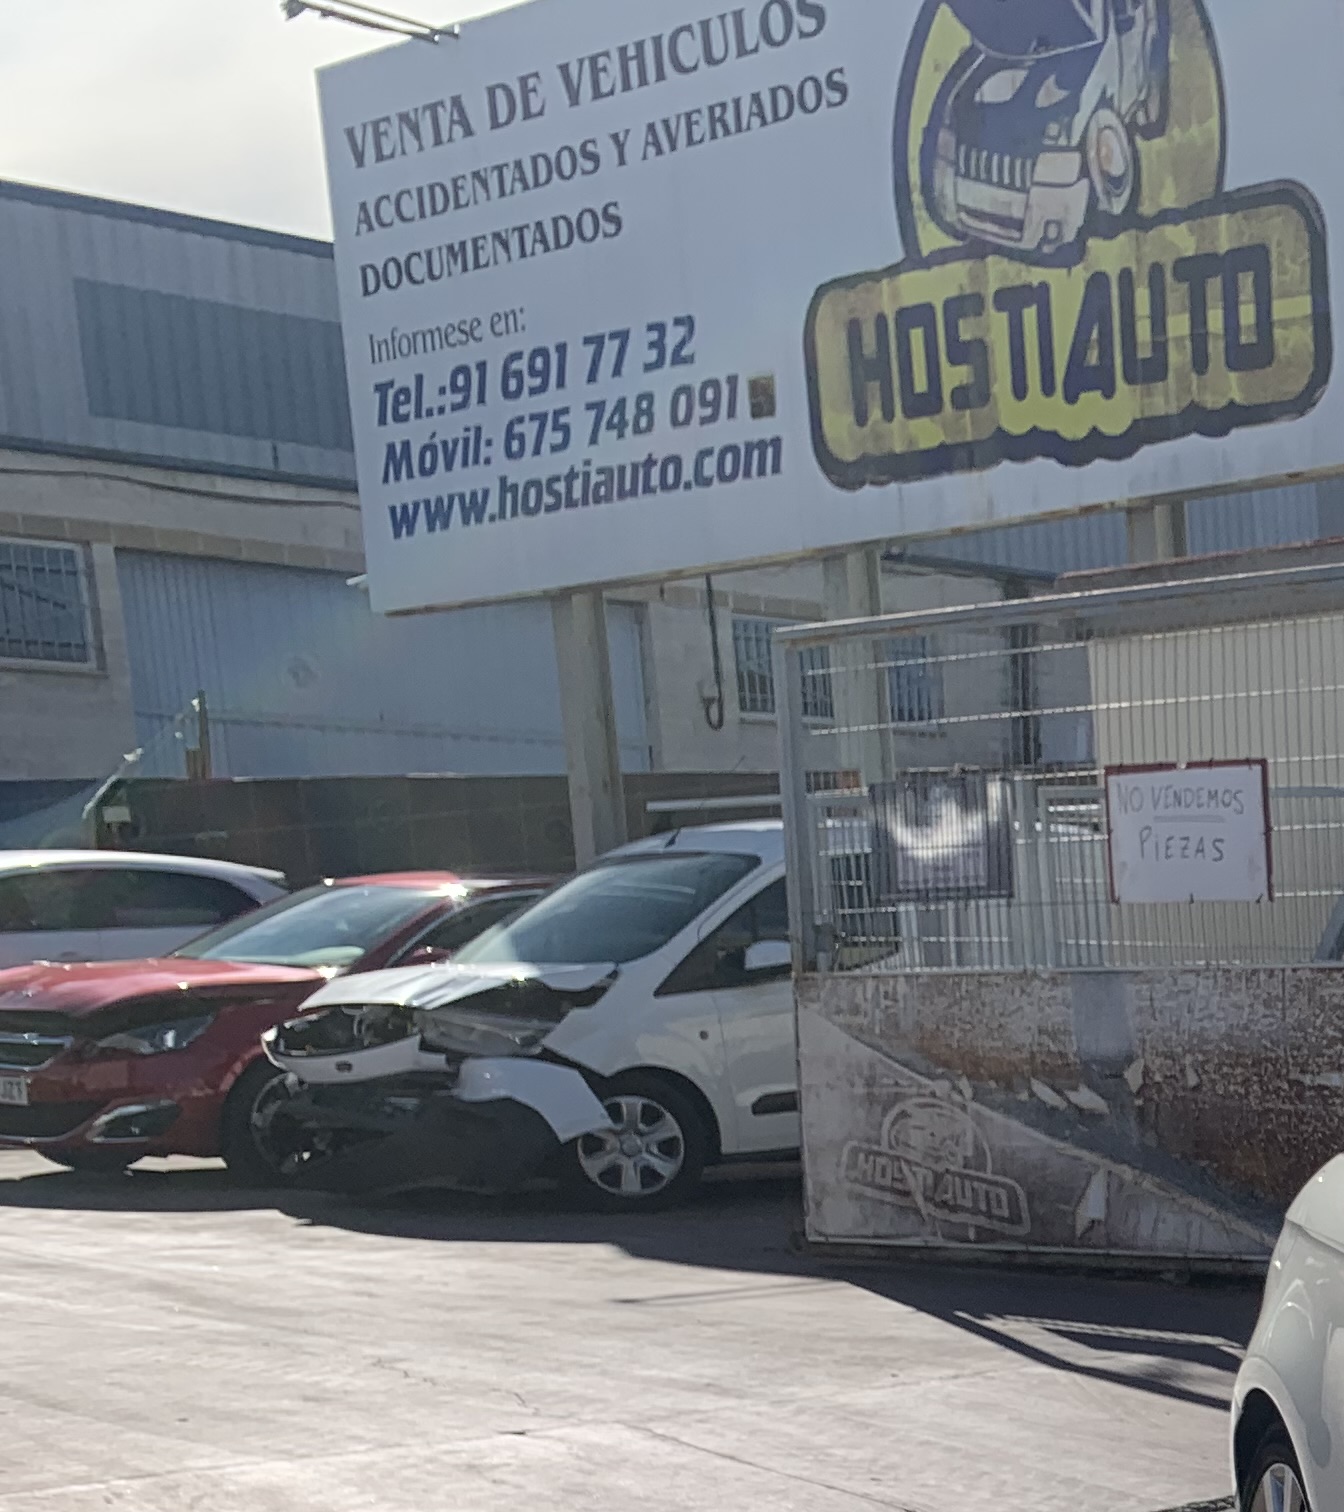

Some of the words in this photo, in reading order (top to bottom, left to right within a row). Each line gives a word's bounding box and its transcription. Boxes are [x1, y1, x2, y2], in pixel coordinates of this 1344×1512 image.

[344, 95, 474, 169] VENTA
[486, 72, 546, 131] DE
[557, 0, 827, 108] VEHICULOS
[355, 139, 600, 236] ACCIDENTADOS
[610, 129, 633, 168] Y
[641, 67, 849, 161] AVERIADOS
[360, 201, 623, 297] DOCUMENTADOS
[369, 326, 483, 365] Informese
[490, 306, 526, 338] en:
[501, 342, 568, 400] 691
[582, 329, 630, 384] 77
[642, 315, 695, 369] 32
[846, 243, 1275, 427] HOSTIAUTO
[382, 430, 493, 485] Móvil:
[503, 406, 571, 460] 675
[584, 391, 654, 446] 748
[669, 373, 739, 427] 091
[387, 435, 783, 540] www.hostiauto.com
[1117, 783, 1144, 814] NO
[1151, 784, 1245, 815] VENDEMOS
